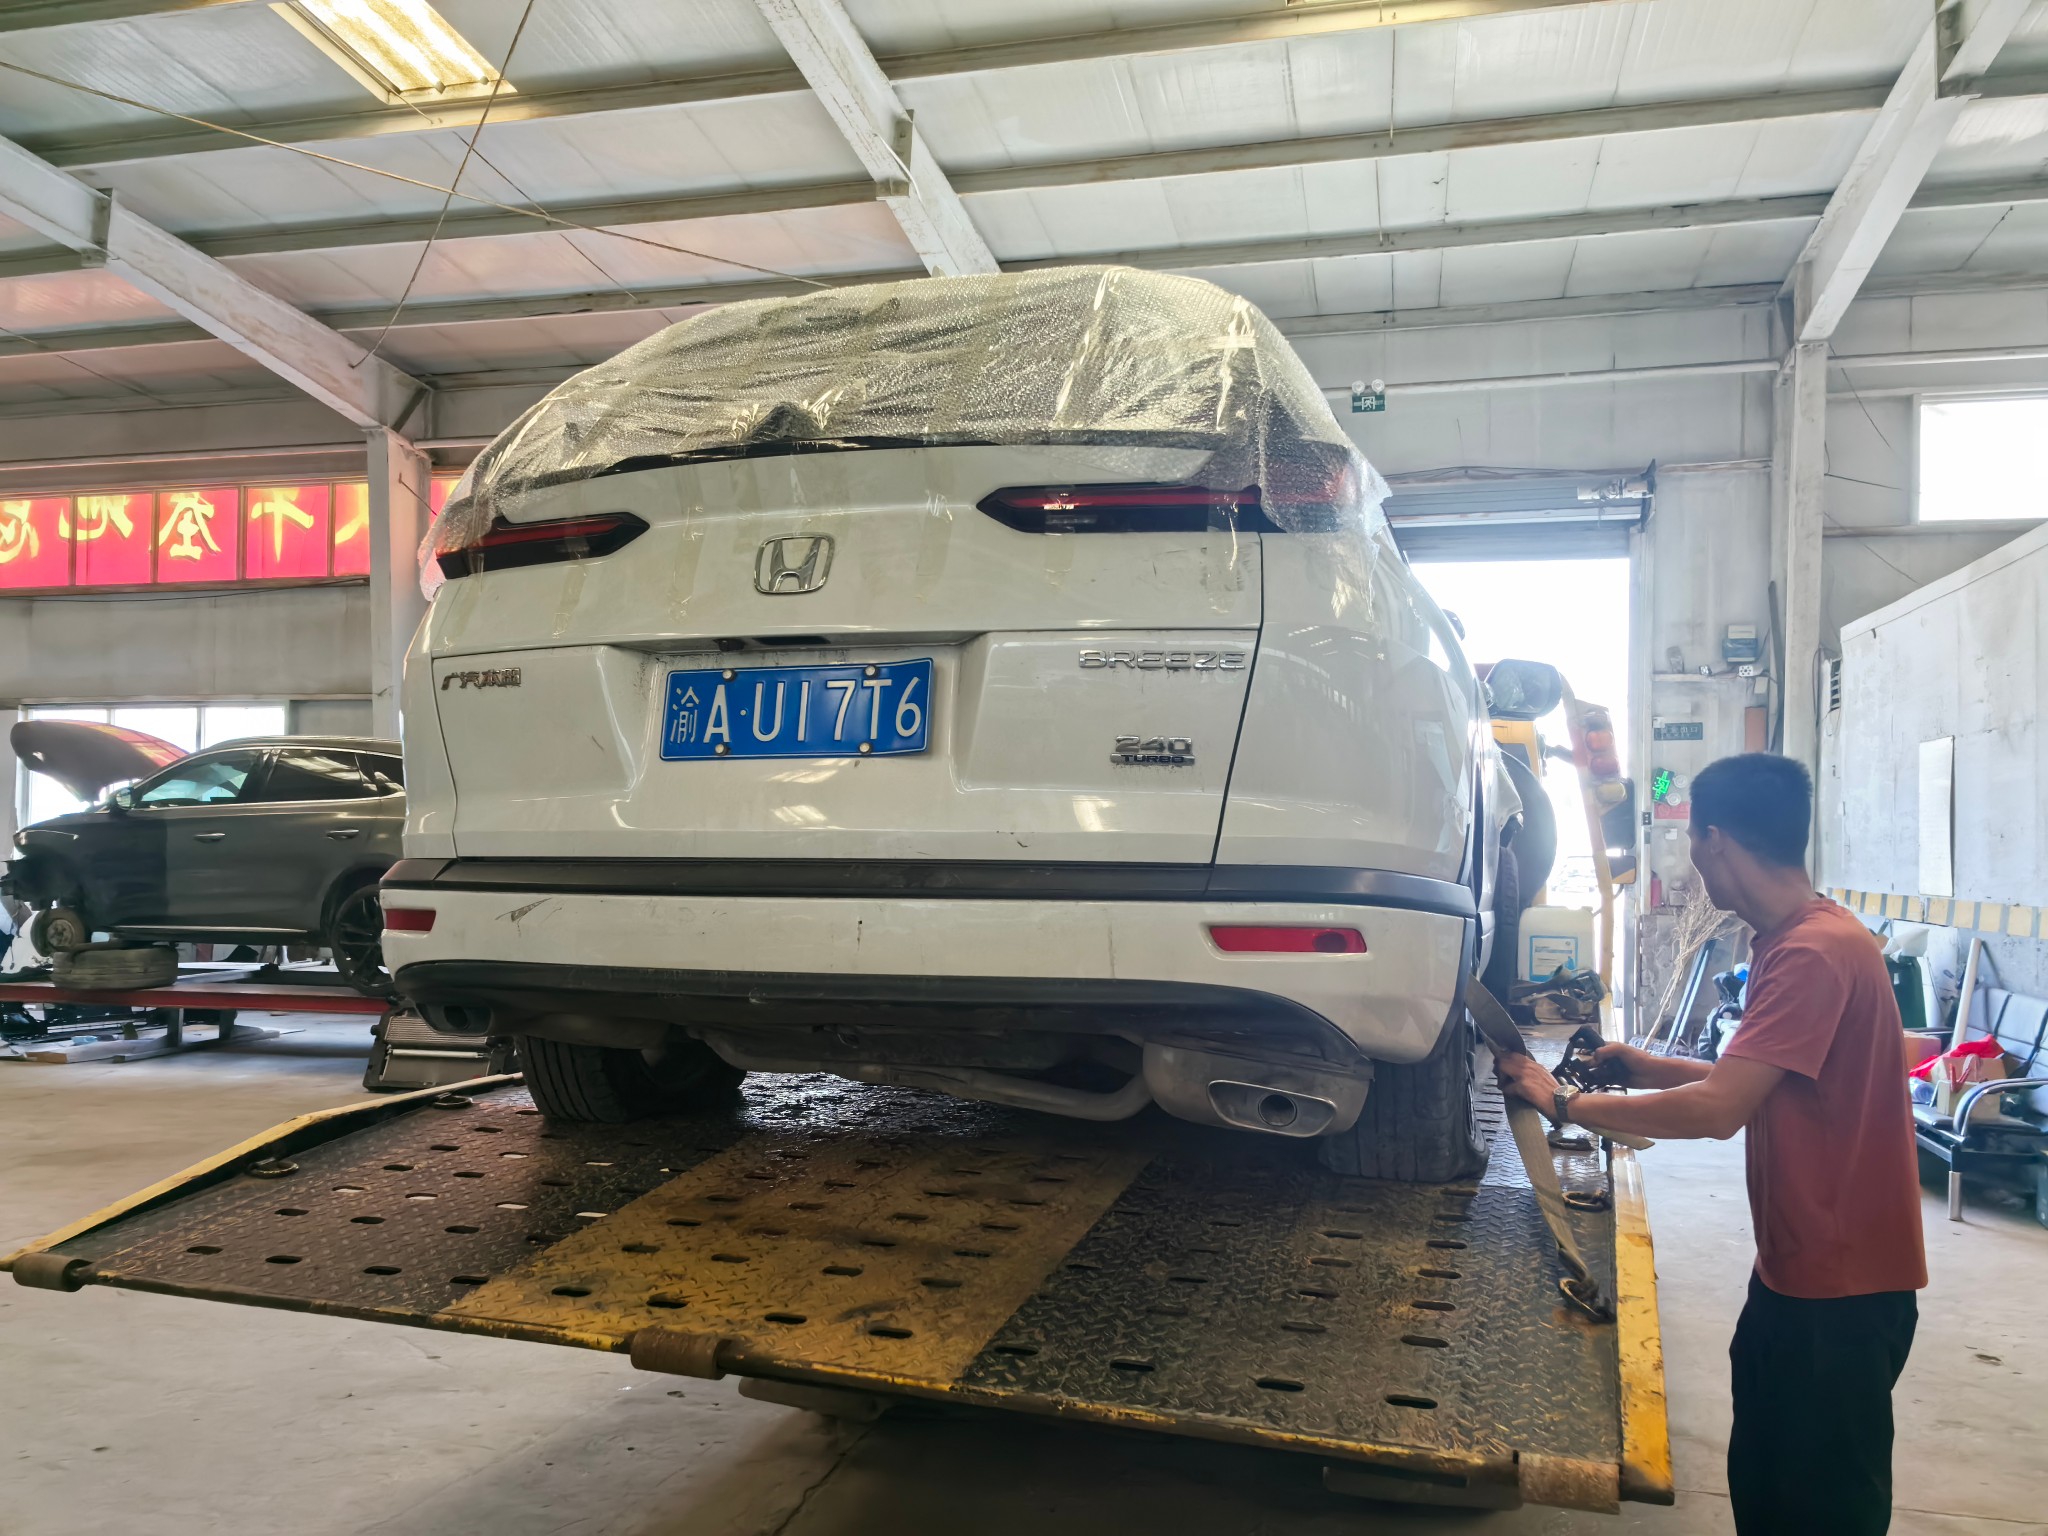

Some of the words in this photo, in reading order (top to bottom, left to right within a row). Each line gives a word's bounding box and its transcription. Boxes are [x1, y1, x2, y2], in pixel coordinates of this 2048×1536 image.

[1079, 650, 1246, 669] BREEZE
[1115, 735, 1193, 754] 240
[1121, 754, 1185, 764] TURBO
